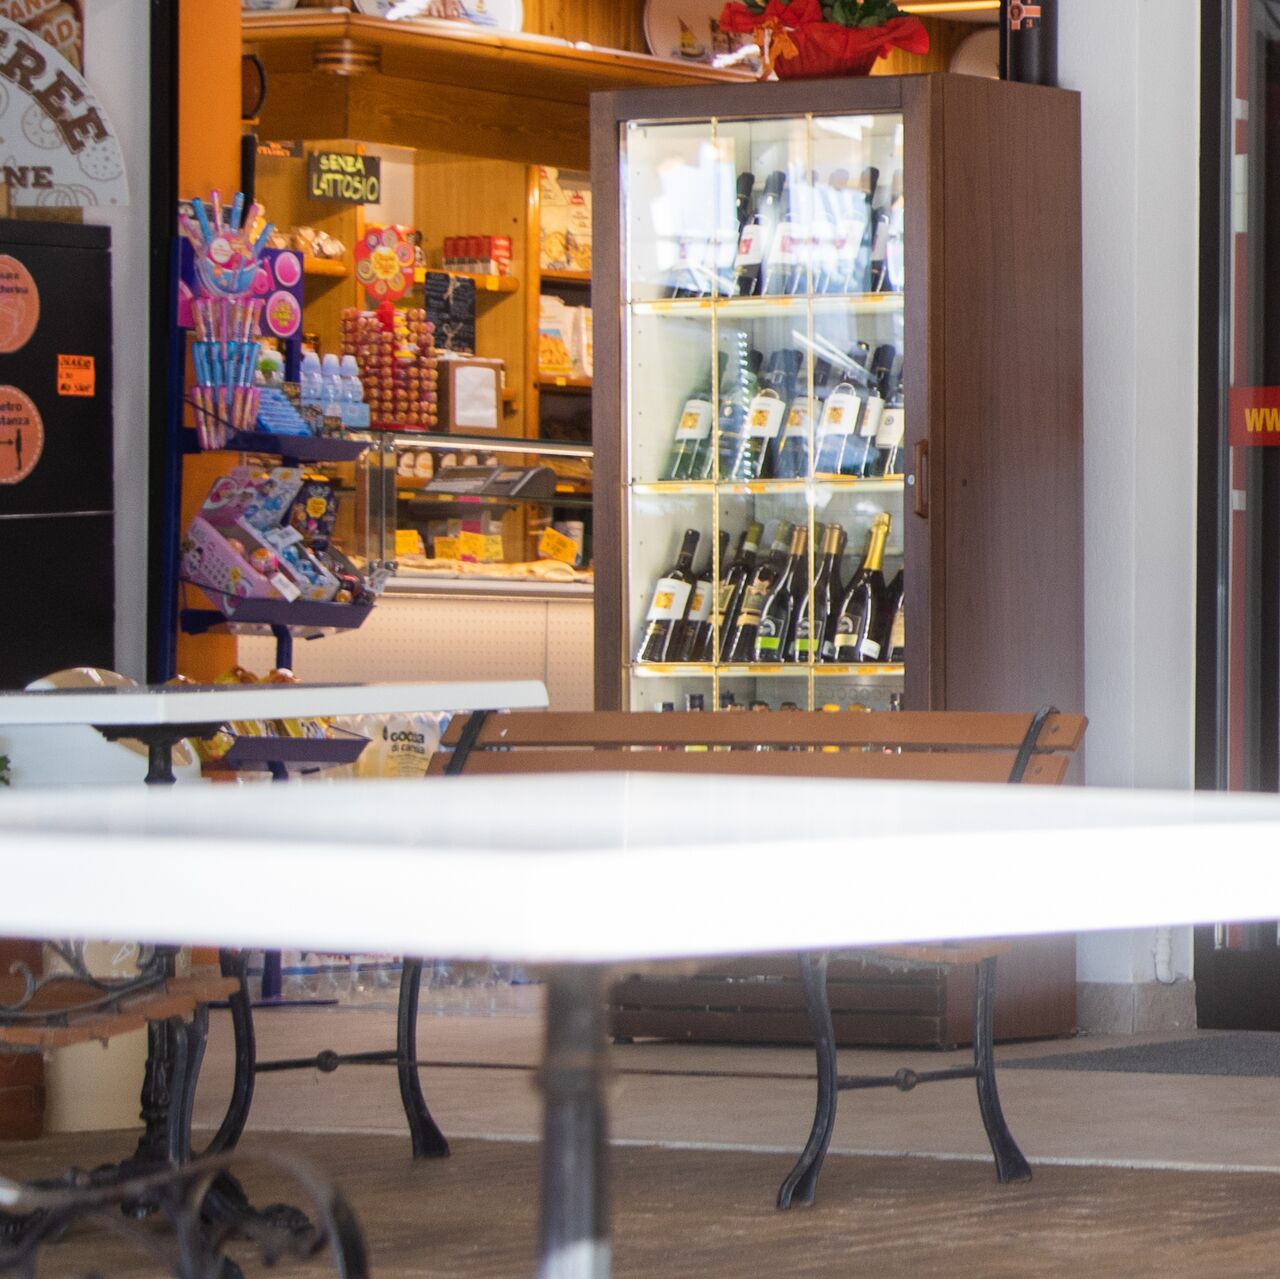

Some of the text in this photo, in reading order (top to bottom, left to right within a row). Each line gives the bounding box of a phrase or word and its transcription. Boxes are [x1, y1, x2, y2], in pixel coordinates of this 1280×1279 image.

[0, 28, 109, 155] REE
[319, 153, 366, 175] SENZA
[312, 172, 379, 202] LATTOSIO
